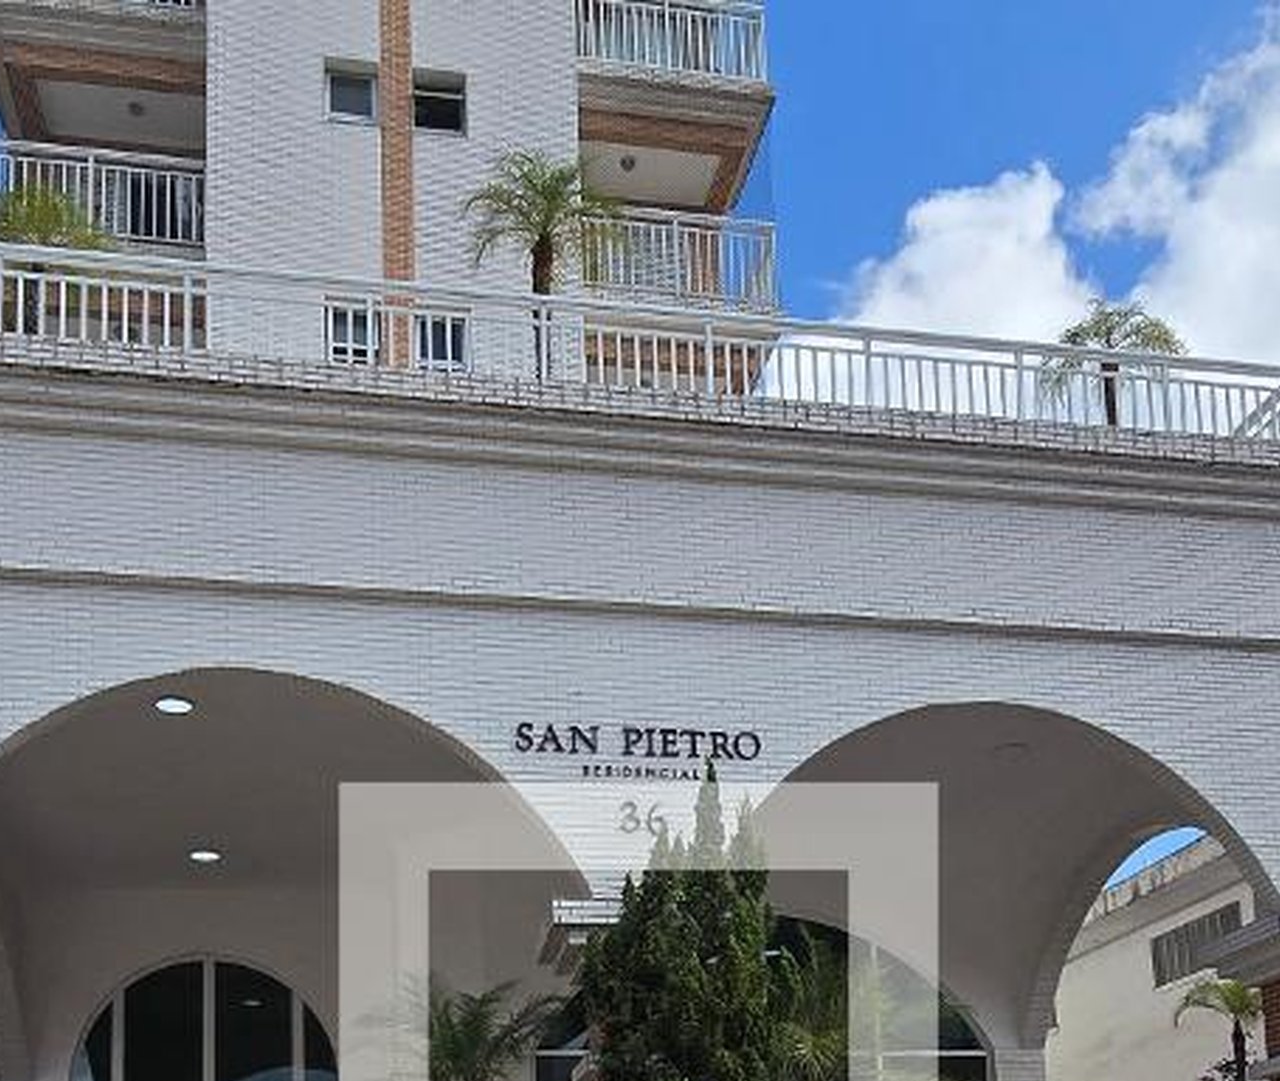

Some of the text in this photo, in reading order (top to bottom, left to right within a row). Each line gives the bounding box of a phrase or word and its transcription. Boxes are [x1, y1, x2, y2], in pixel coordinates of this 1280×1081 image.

[514, 722, 762, 761] SAN PIETRO
[582, 764, 701, 781] RESIDENCIAL
